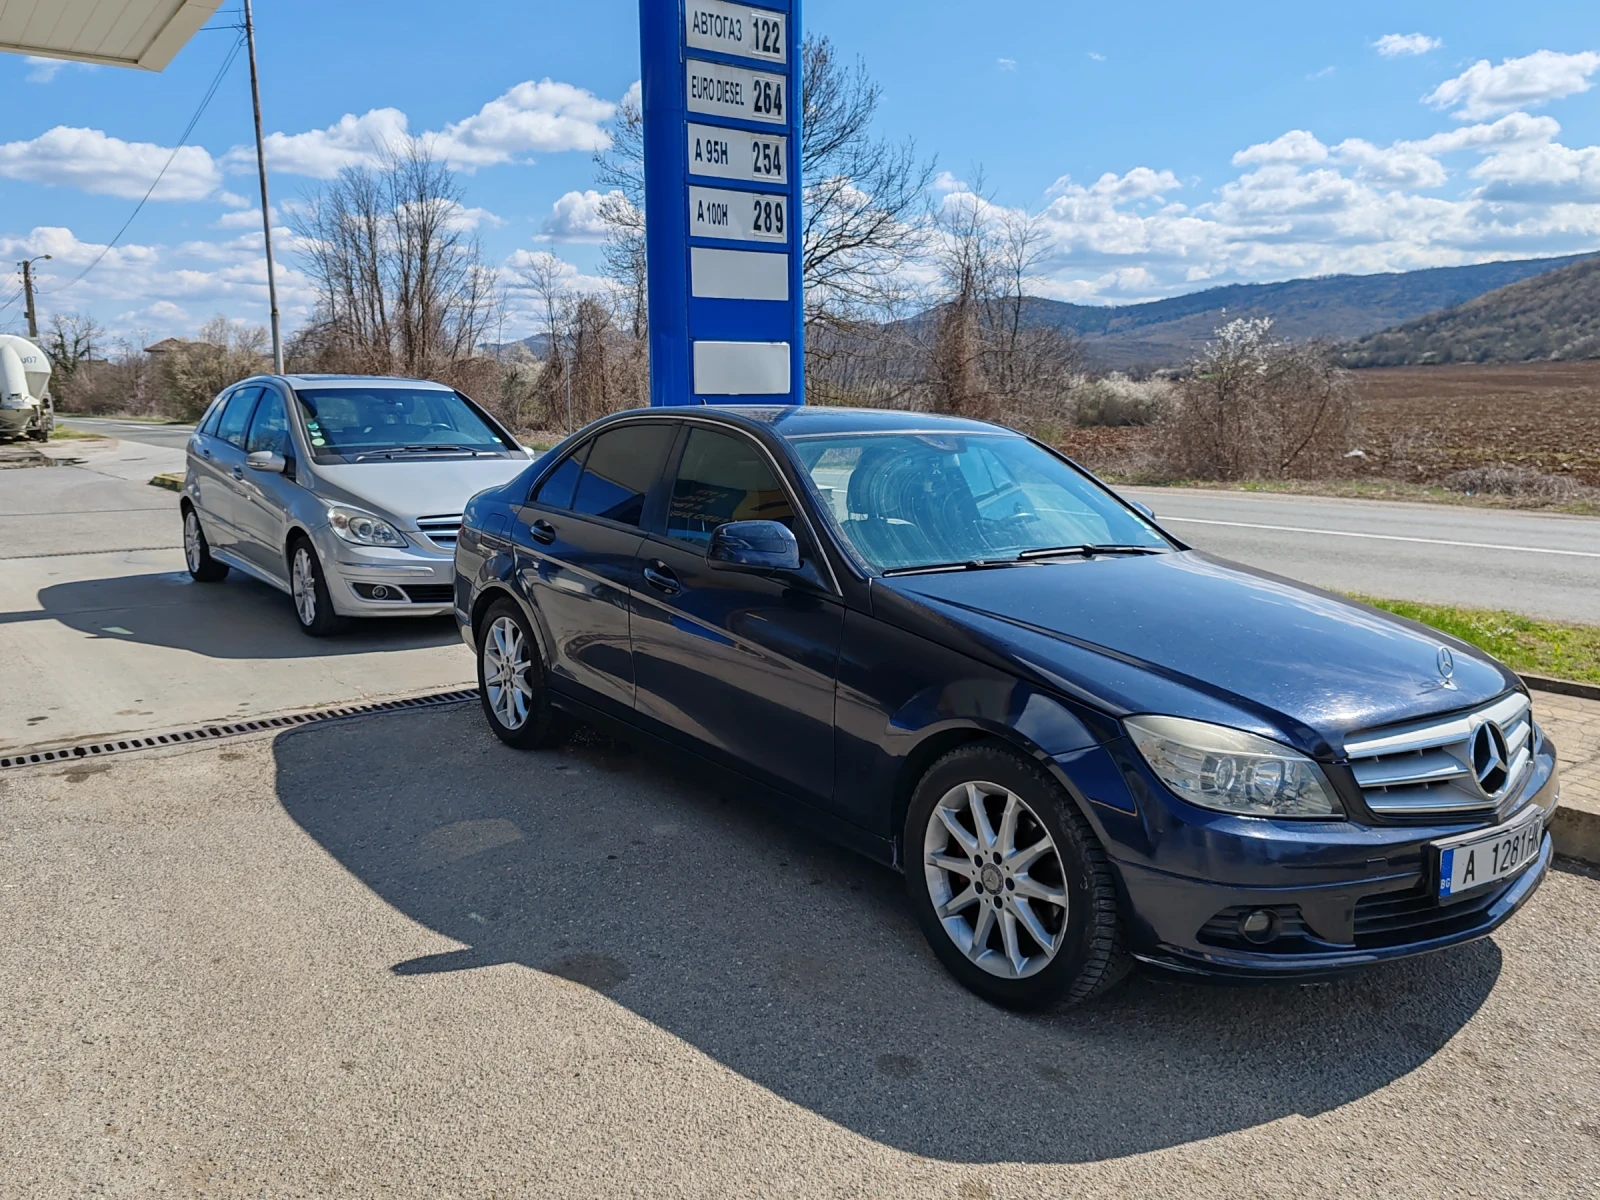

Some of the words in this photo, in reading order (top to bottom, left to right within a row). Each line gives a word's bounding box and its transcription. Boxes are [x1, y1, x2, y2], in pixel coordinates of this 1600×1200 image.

[692, 10, 743, 42] АВТОГАЗ
[752, 18, 781, 54] 122
[691, 76, 715, 102] EURO
[716, 82, 745, 106] DIESEL
[753, 80, 782, 116] 264
[694, 138, 703, 162] A
[706, 139, 729, 165] 95H
[752, 141, 782, 176] 254
[696, 200, 705, 222] A
[706, 202, 728, 226] 100H
[753, 200, 784, 233] 289
[1440, 878, 1451, 889] BG
[1463, 850, 1475, 884] A
